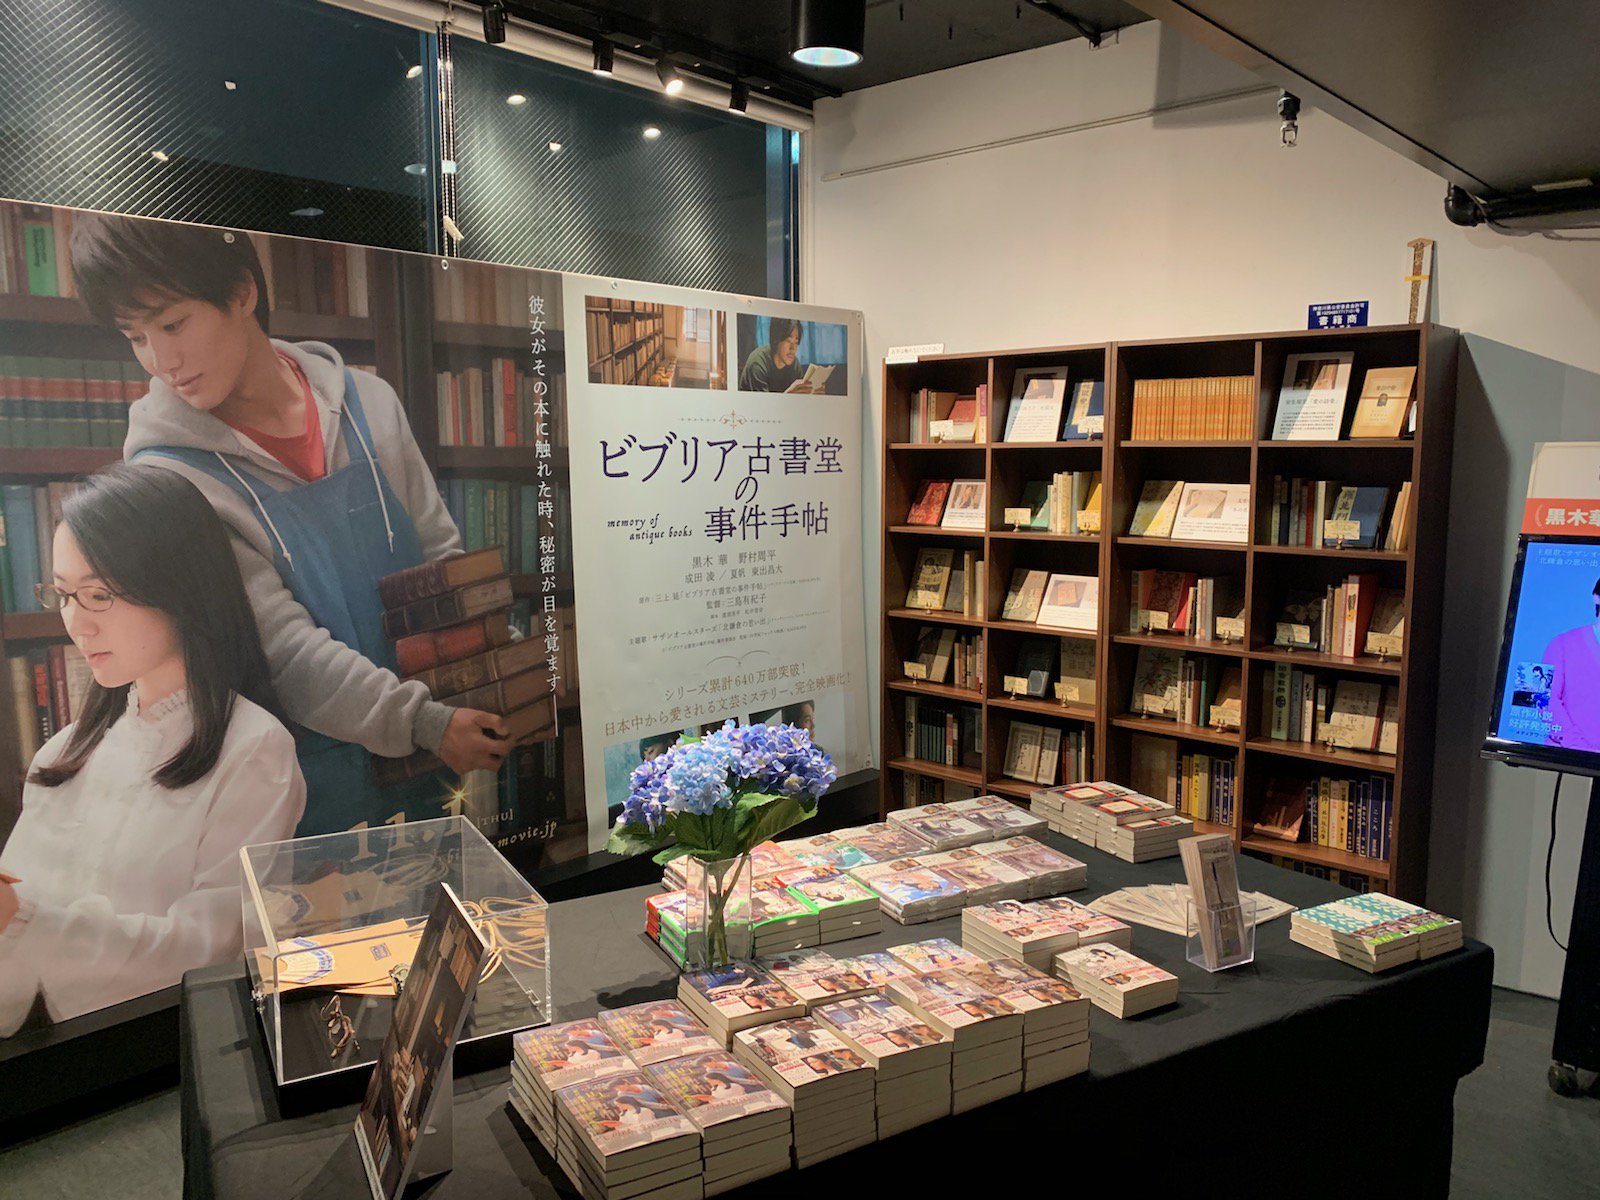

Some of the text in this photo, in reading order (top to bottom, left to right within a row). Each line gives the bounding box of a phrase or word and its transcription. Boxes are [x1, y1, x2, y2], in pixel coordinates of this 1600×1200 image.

[599, 430, 844, 484] ビブリア古書堂
[735, 475, 760, 504] の
[607, 513, 662, 529] memory of
[703, 501, 829, 543] 事件手帖
[629, 525, 693, 545] antique books
[738, 549, 777, 564] 野村周平
[685, 571, 703, 584] 成田
[751, 564, 783, 578] 東出昌大
